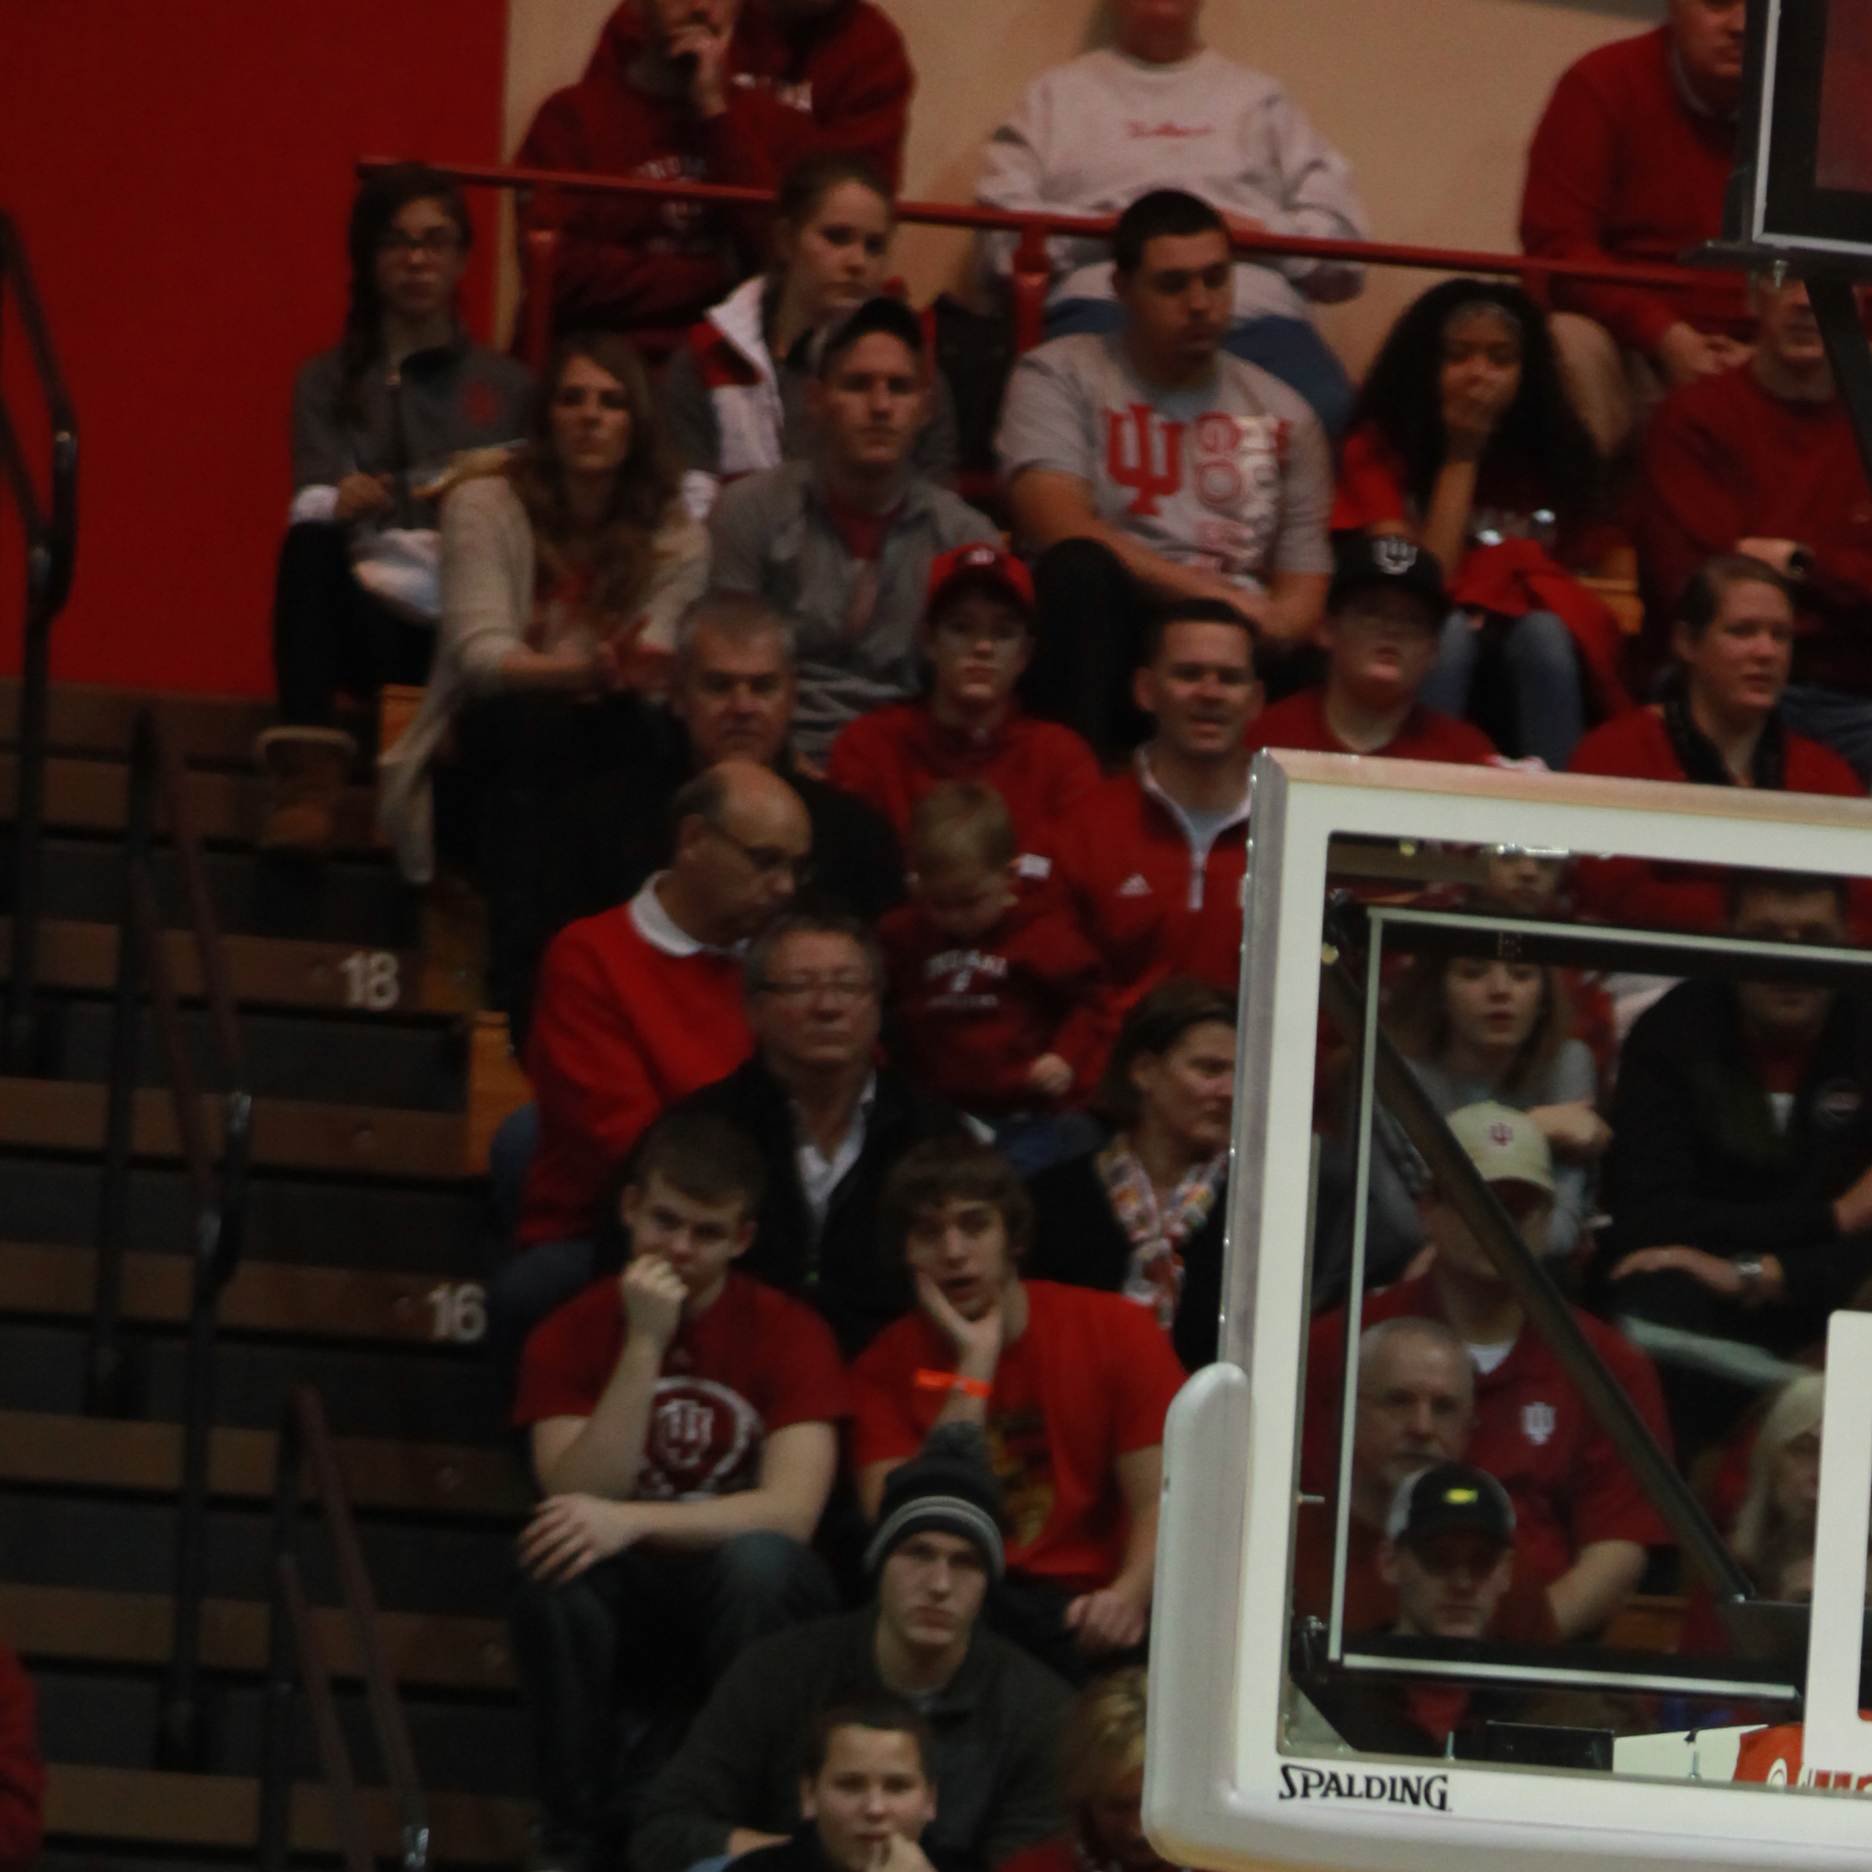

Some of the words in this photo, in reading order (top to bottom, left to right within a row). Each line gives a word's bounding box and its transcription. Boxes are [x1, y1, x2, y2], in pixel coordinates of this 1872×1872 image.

[341, 950, 400, 1010] 18
[428, 1281, 487, 1345] 16
[1279, 1763, 1449, 1813] SPALDING
